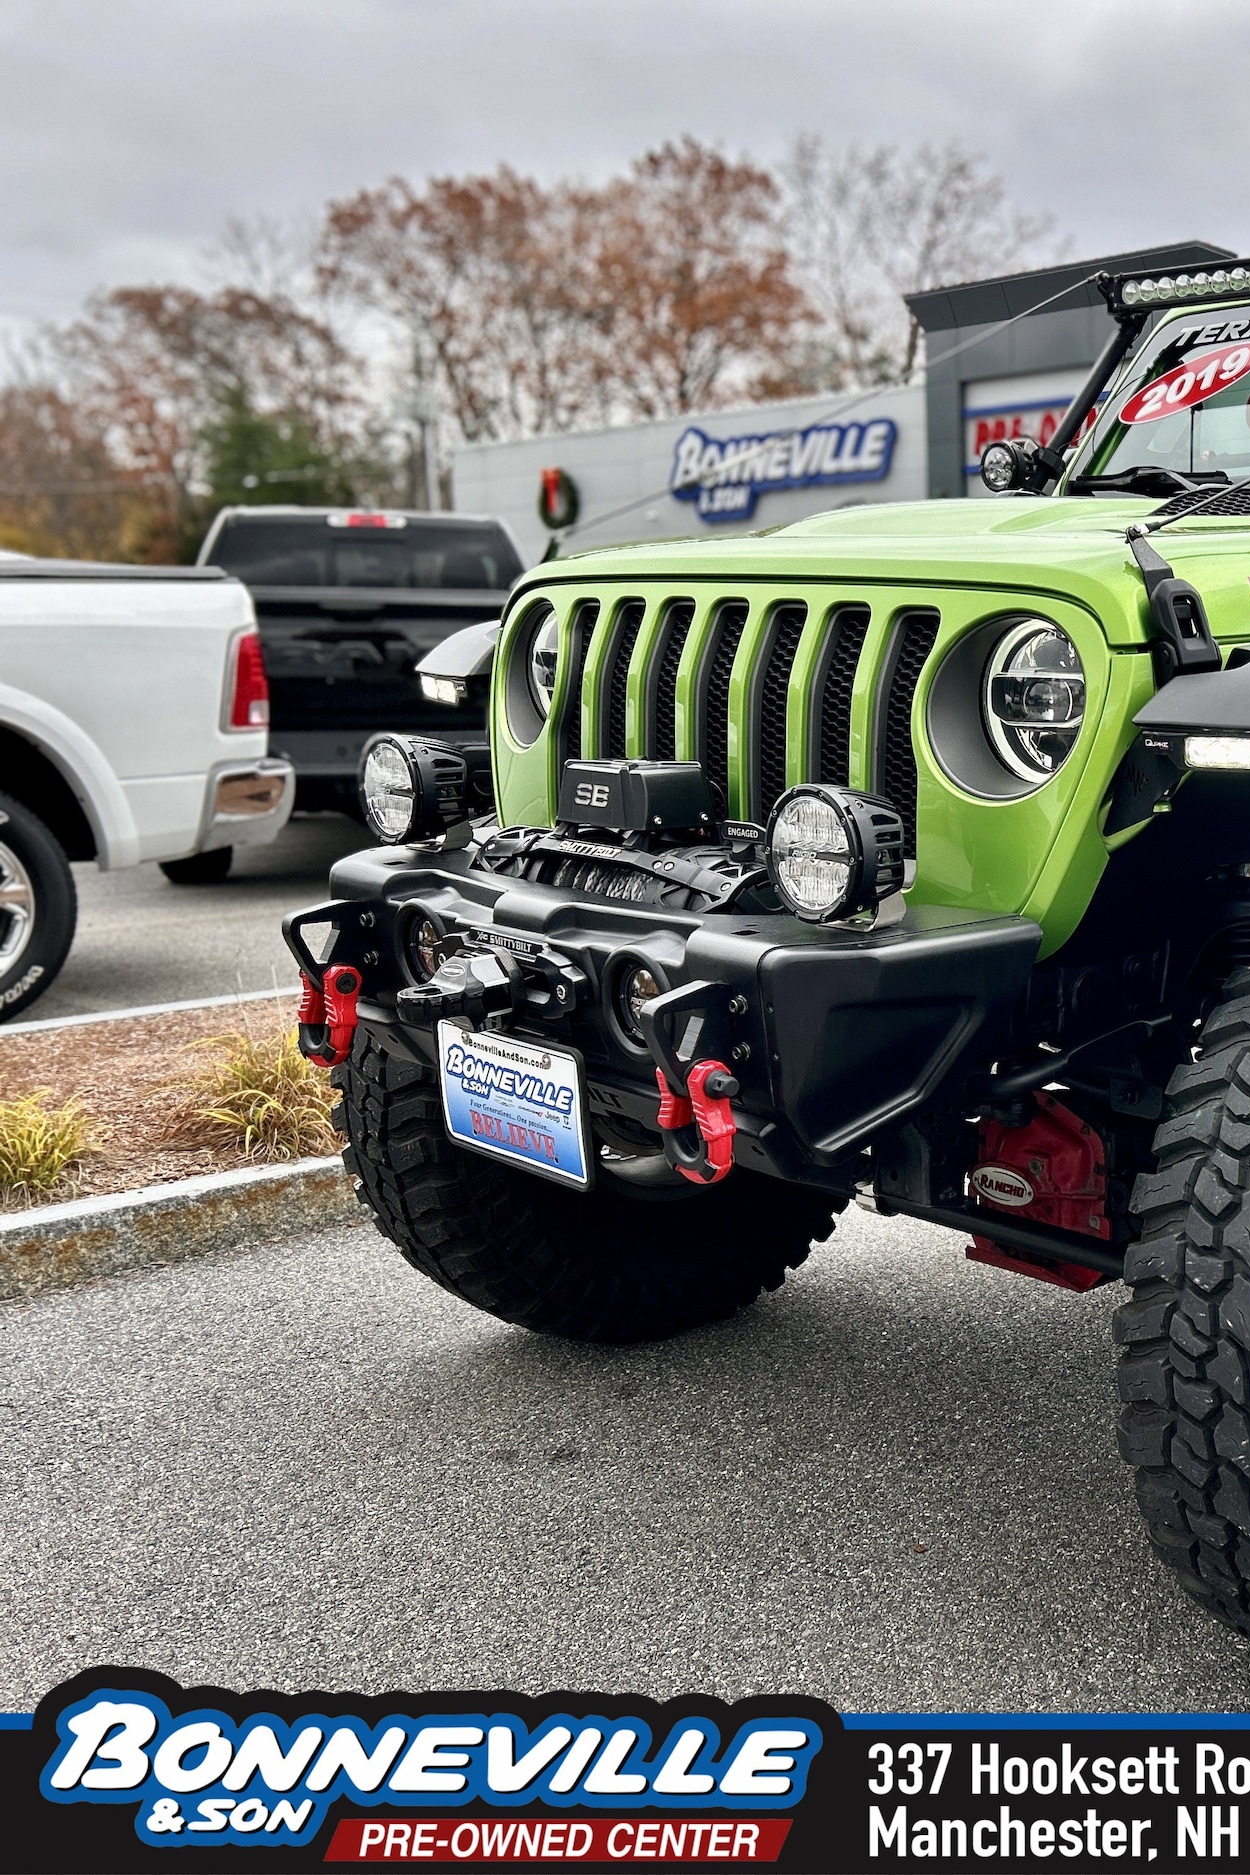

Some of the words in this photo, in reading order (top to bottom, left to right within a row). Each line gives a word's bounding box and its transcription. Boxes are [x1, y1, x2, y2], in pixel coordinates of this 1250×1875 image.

[1141, 346, 1250, 419] 2019
[675, 420, 889, 486] BONNEVILLE
[727, 826, 759, 840] ENGAGED
[489, 933, 533, 954] SMITTYBILT
[447, 1046, 572, 1111] BONNEVILLE
[979, 1174, 1026, 1199] RANCHO
